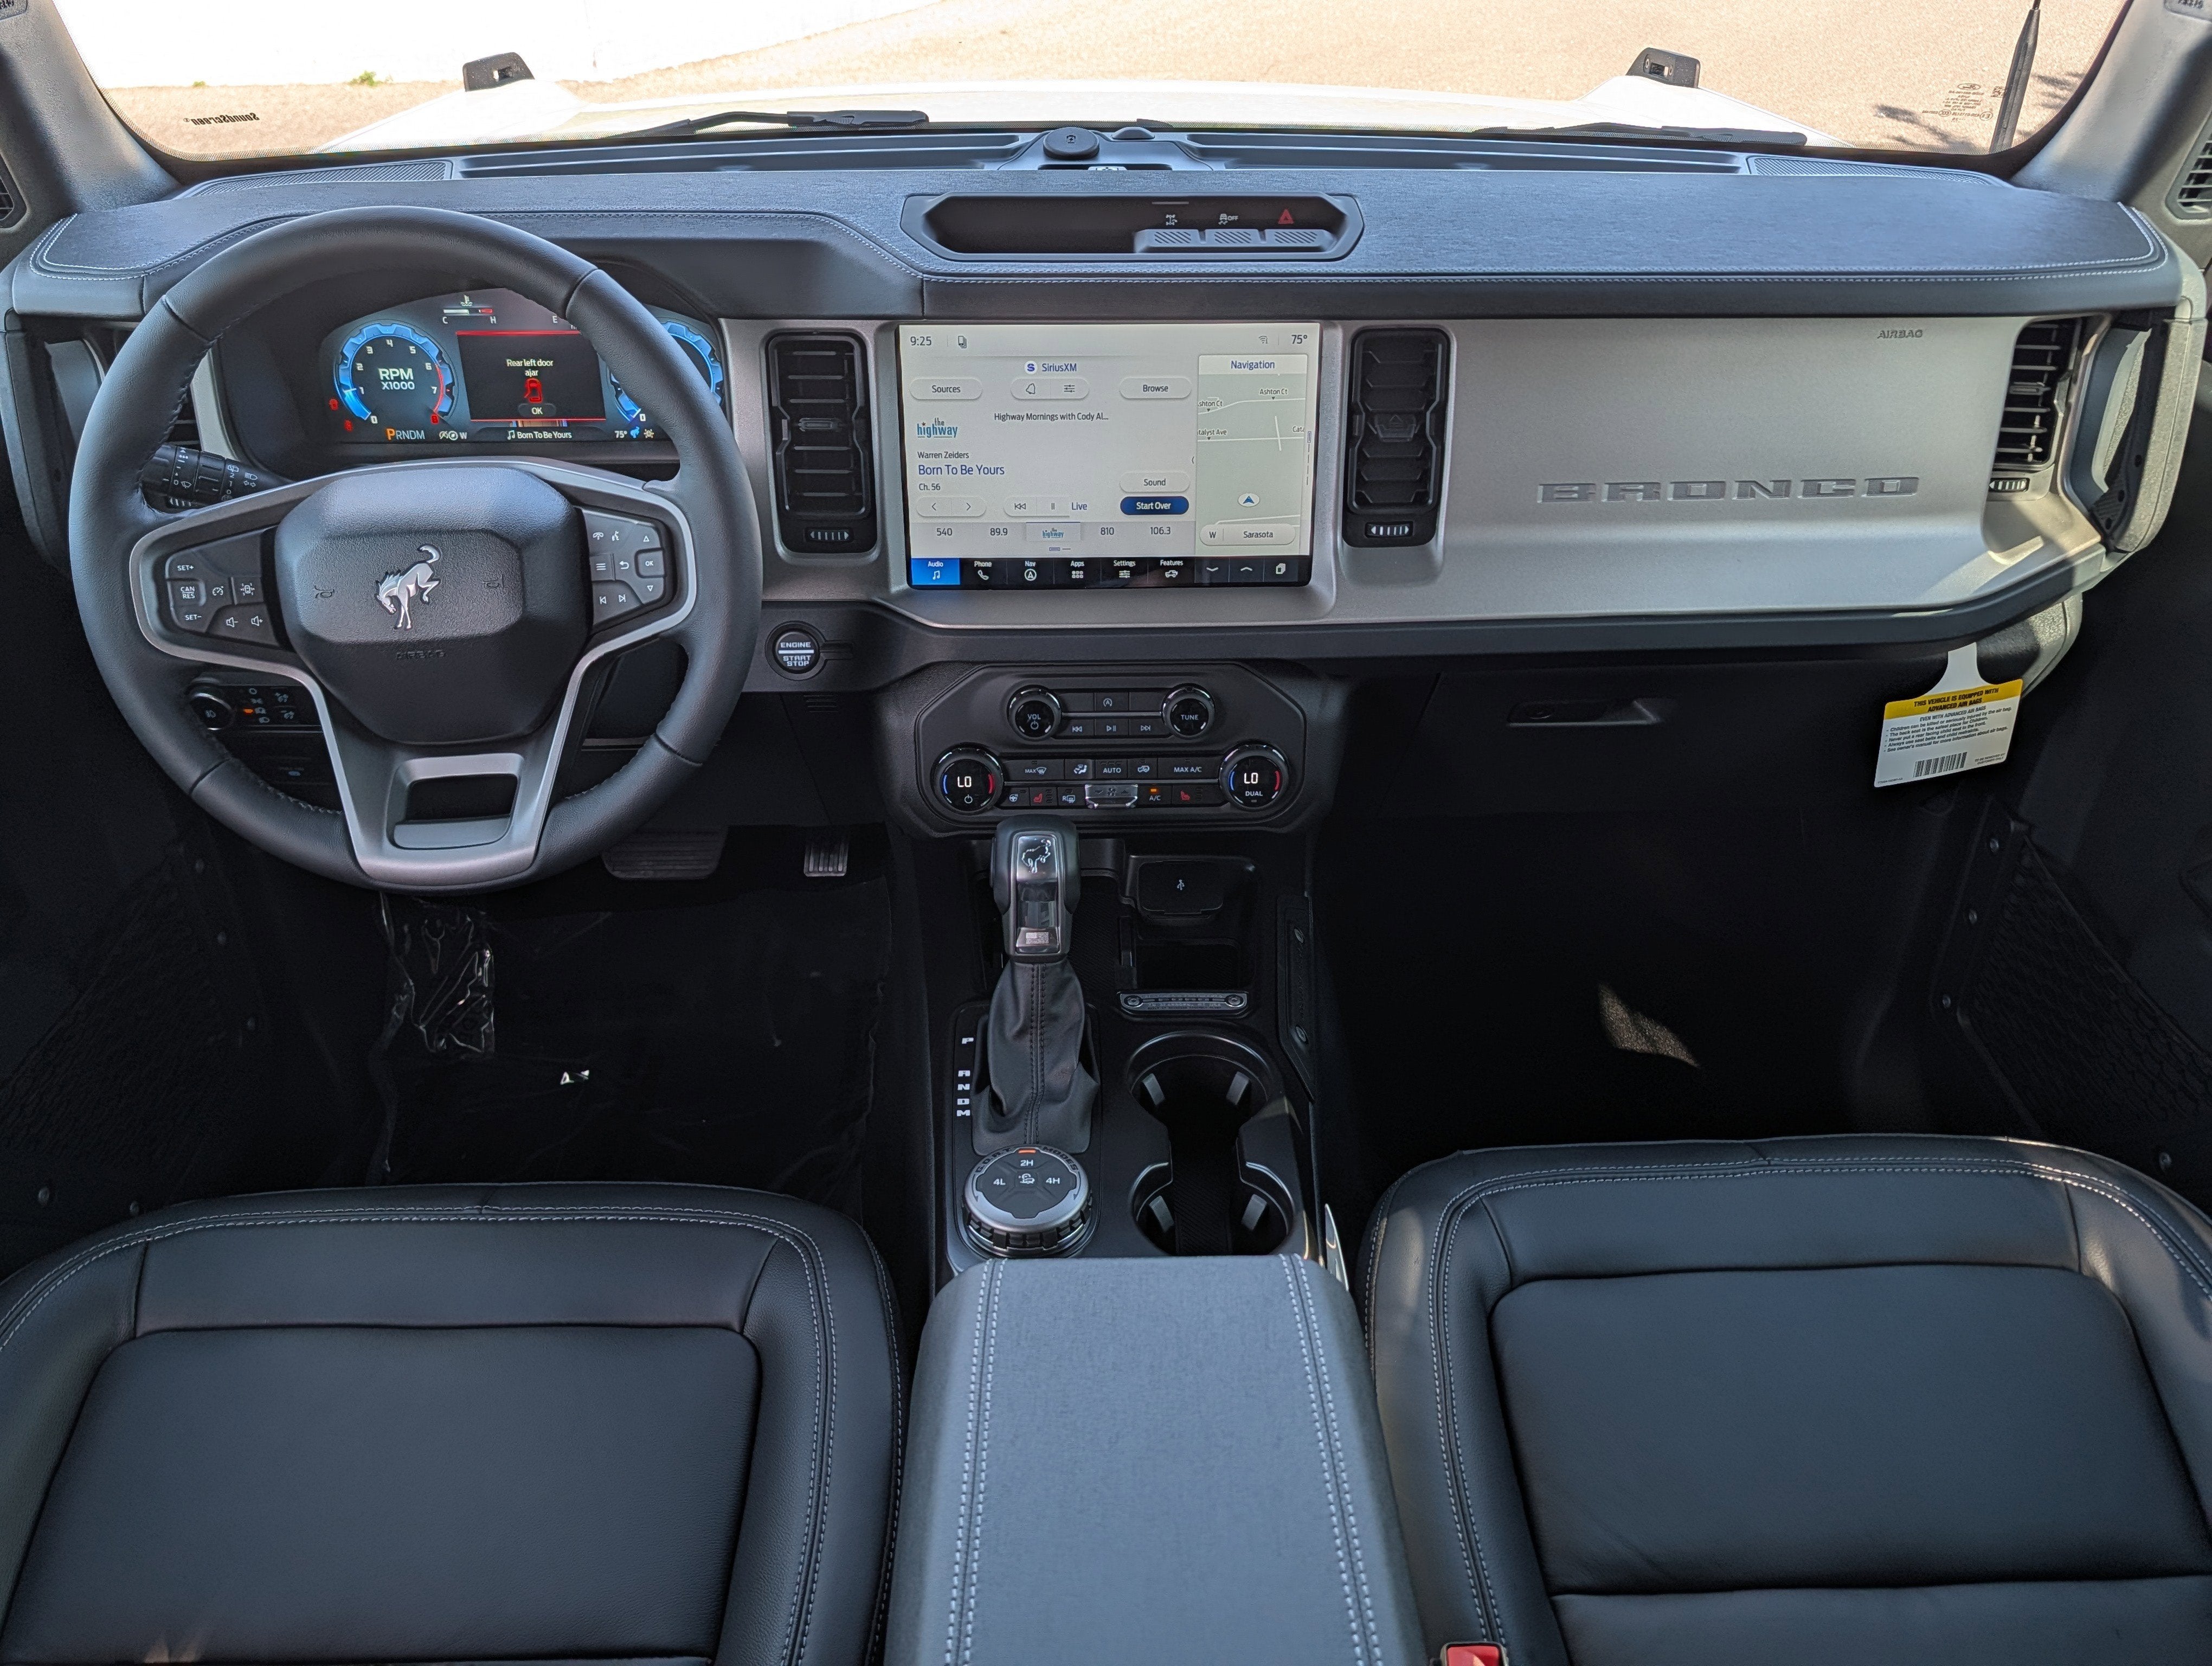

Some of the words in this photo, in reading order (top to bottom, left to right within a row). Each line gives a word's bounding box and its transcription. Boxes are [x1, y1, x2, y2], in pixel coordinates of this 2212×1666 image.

[1876, 329, 1924, 339] AIRBAG
[910, 336, 932, 346] 9:25
[1291, 335, 1308, 344] 75°
[366, 346, 373, 354] 3
[1042, 363, 1077, 372] SiriusXM
[1231, 360, 1275, 370] Navigation
[378, 368, 414, 380] RPM
[381, 381, 415, 390] X1000
[370, 416, 378, 424] 0
[640, 414, 646, 422] 0
[994, 413, 1025, 421] Highway
[1026, 413, 1058, 421] Mornings
[1077, 413, 1094, 421] Cody
[935, 418, 944, 426] the
[615, 430, 627, 438] 75°
[917, 422, 958, 438] highway
[517, 431, 533, 439] Born
[533, 431, 543, 439] To
[543, 431, 552, 439] Be
[553, 431, 572, 439] Yours
[918, 465, 942, 476] Born
[945, 465, 958, 476] To
[961, 465, 974, 476] Be
[975, 465, 1005, 476] Yours
[1537, 477, 1920, 503] BRONCO
[1071, 502, 1088, 510] Live
[936, 528, 953, 536] 540
[990, 528, 1008, 536] 89.9
[1101, 527, 1115, 535] 810
[1150, 527, 1171, 535] 106.3
[1113, 560, 1136, 568] Settings
[1927, 696, 1950, 705] VEHICLE
[1958, 690, 1983, 700] EQUIPPED
[1927, 702, 1957, 712] ADVANCED
[1043, 1146, 1078, 1170] MODES
